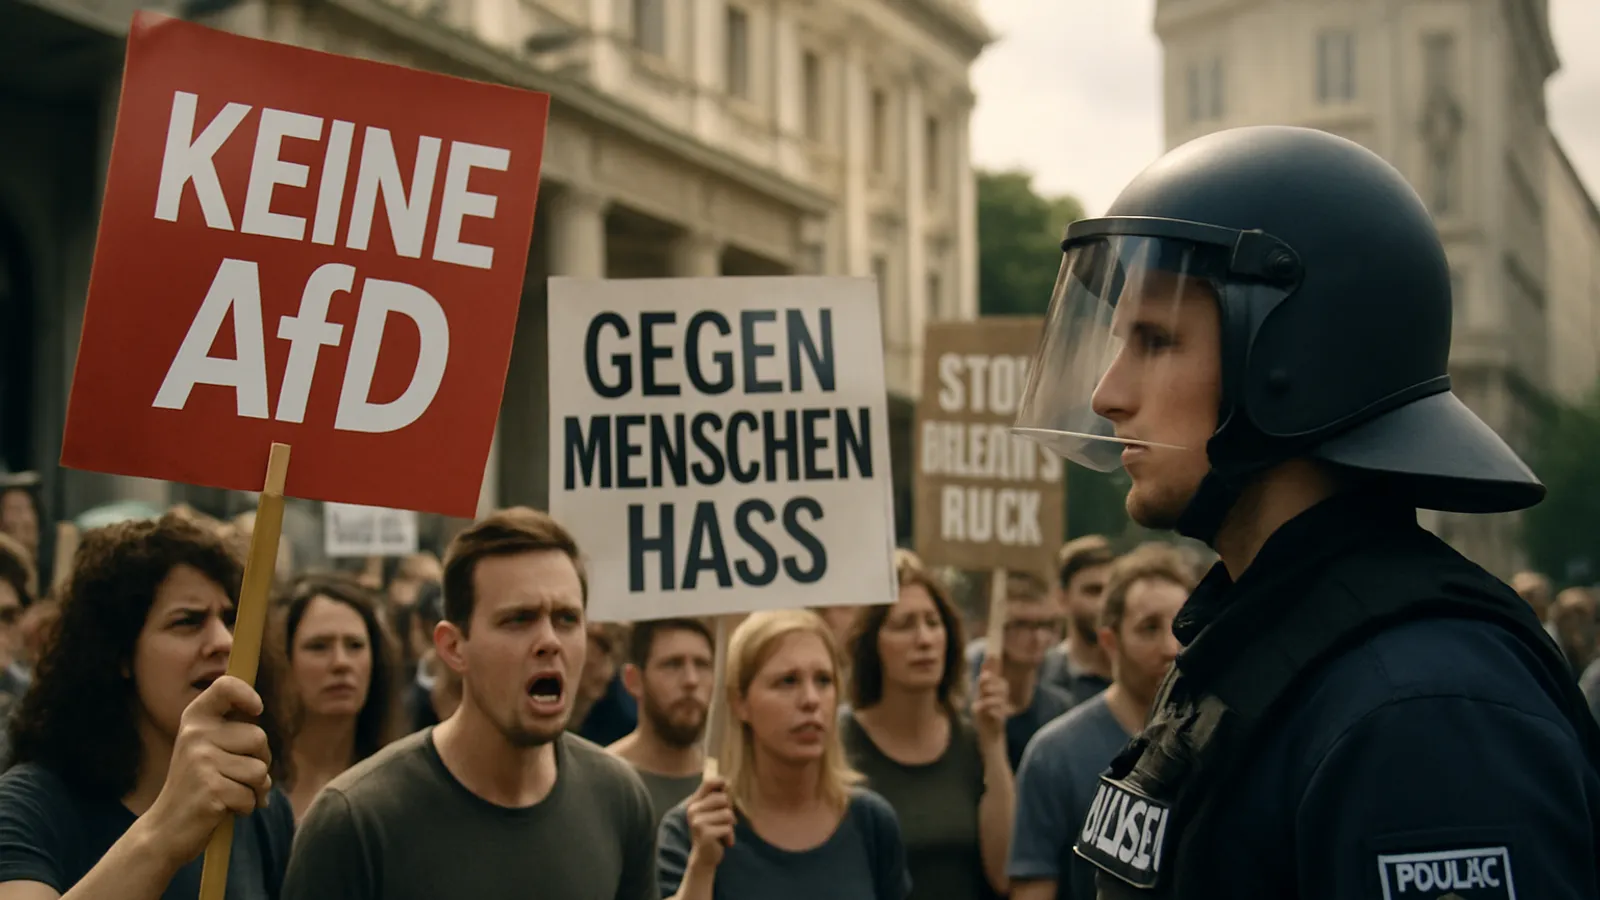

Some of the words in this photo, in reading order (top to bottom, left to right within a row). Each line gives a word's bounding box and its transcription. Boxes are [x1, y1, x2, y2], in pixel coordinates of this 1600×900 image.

[154, 90, 511, 270] KEINE
[151, 257, 450, 434] AfD
[585, 308, 836, 399] GEGEN
[564, 407, 874, 491] MENSCHEN
[628, 496, 828, 593] HASS
[941, 484, 1043, 547] RUCK
